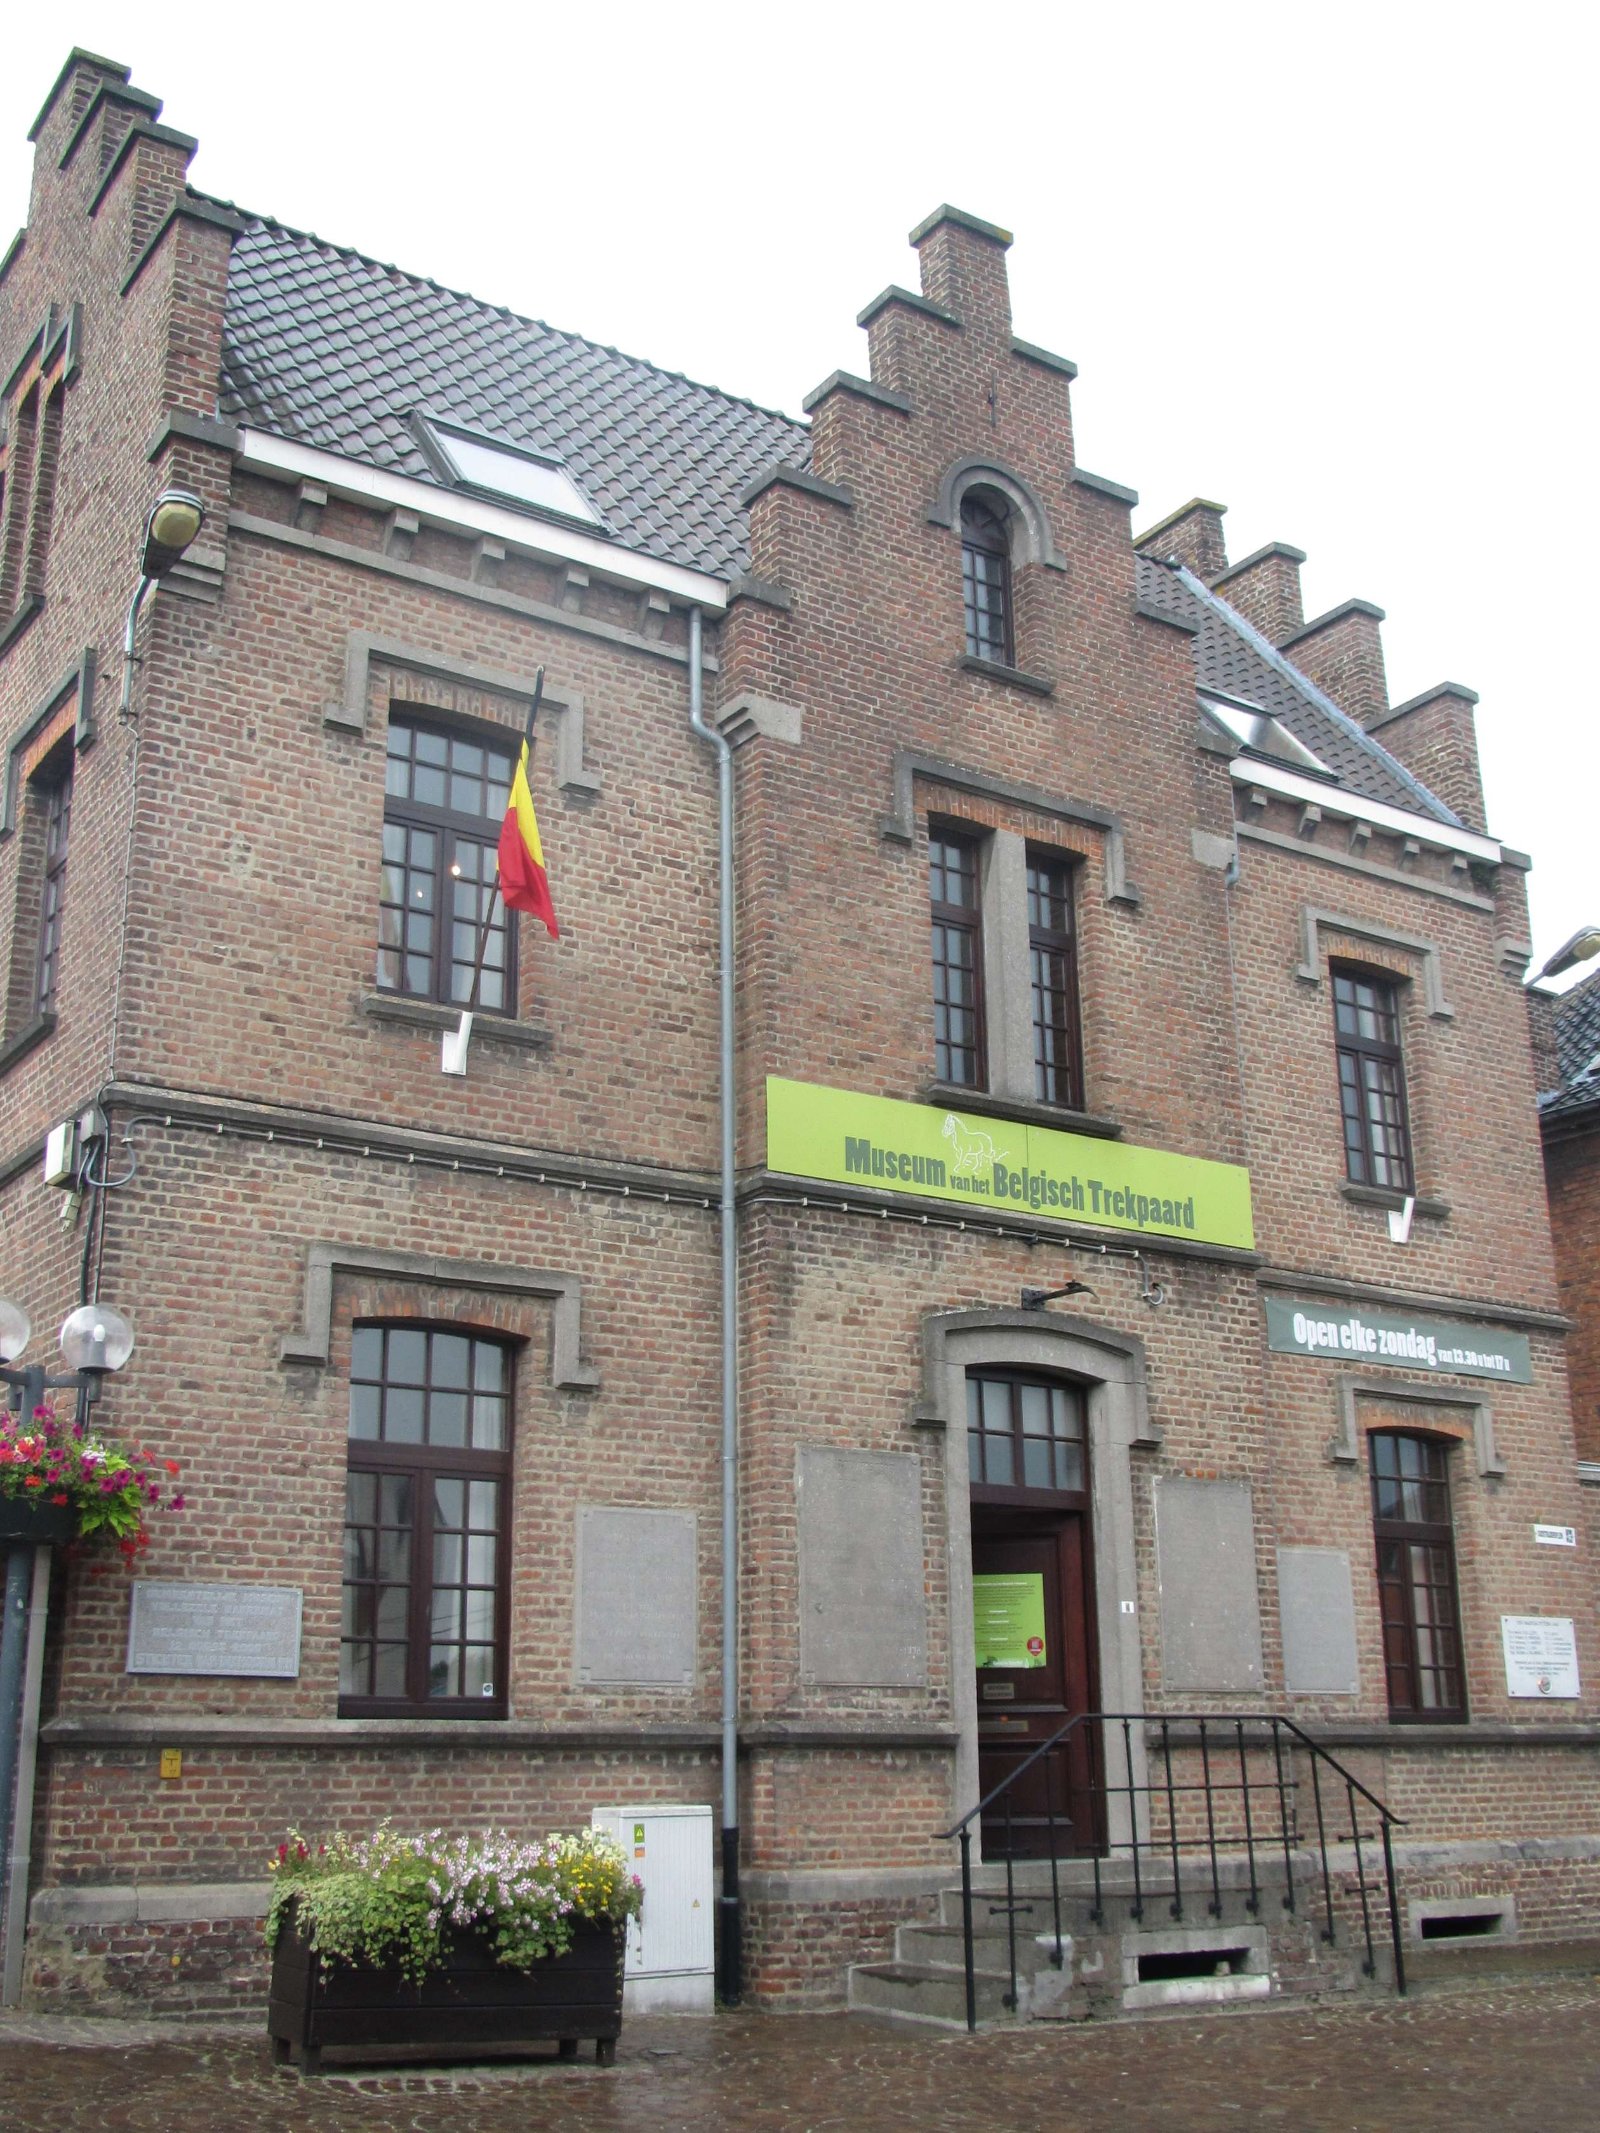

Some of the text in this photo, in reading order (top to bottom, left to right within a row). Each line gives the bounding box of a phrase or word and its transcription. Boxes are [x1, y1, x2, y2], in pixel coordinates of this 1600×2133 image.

[845, 1136, 1195, 1230] Museum van het Belgisch Trekpaard
[1293, 1312, 1339, 1351] Open
[1340, 1319, 1377, 1353] elke
[1378, 1327, 1438, 1367] zondag
[1437, 1348, 1453, 1363] van
[1452, 1348, 1478, 1366] 13.30
